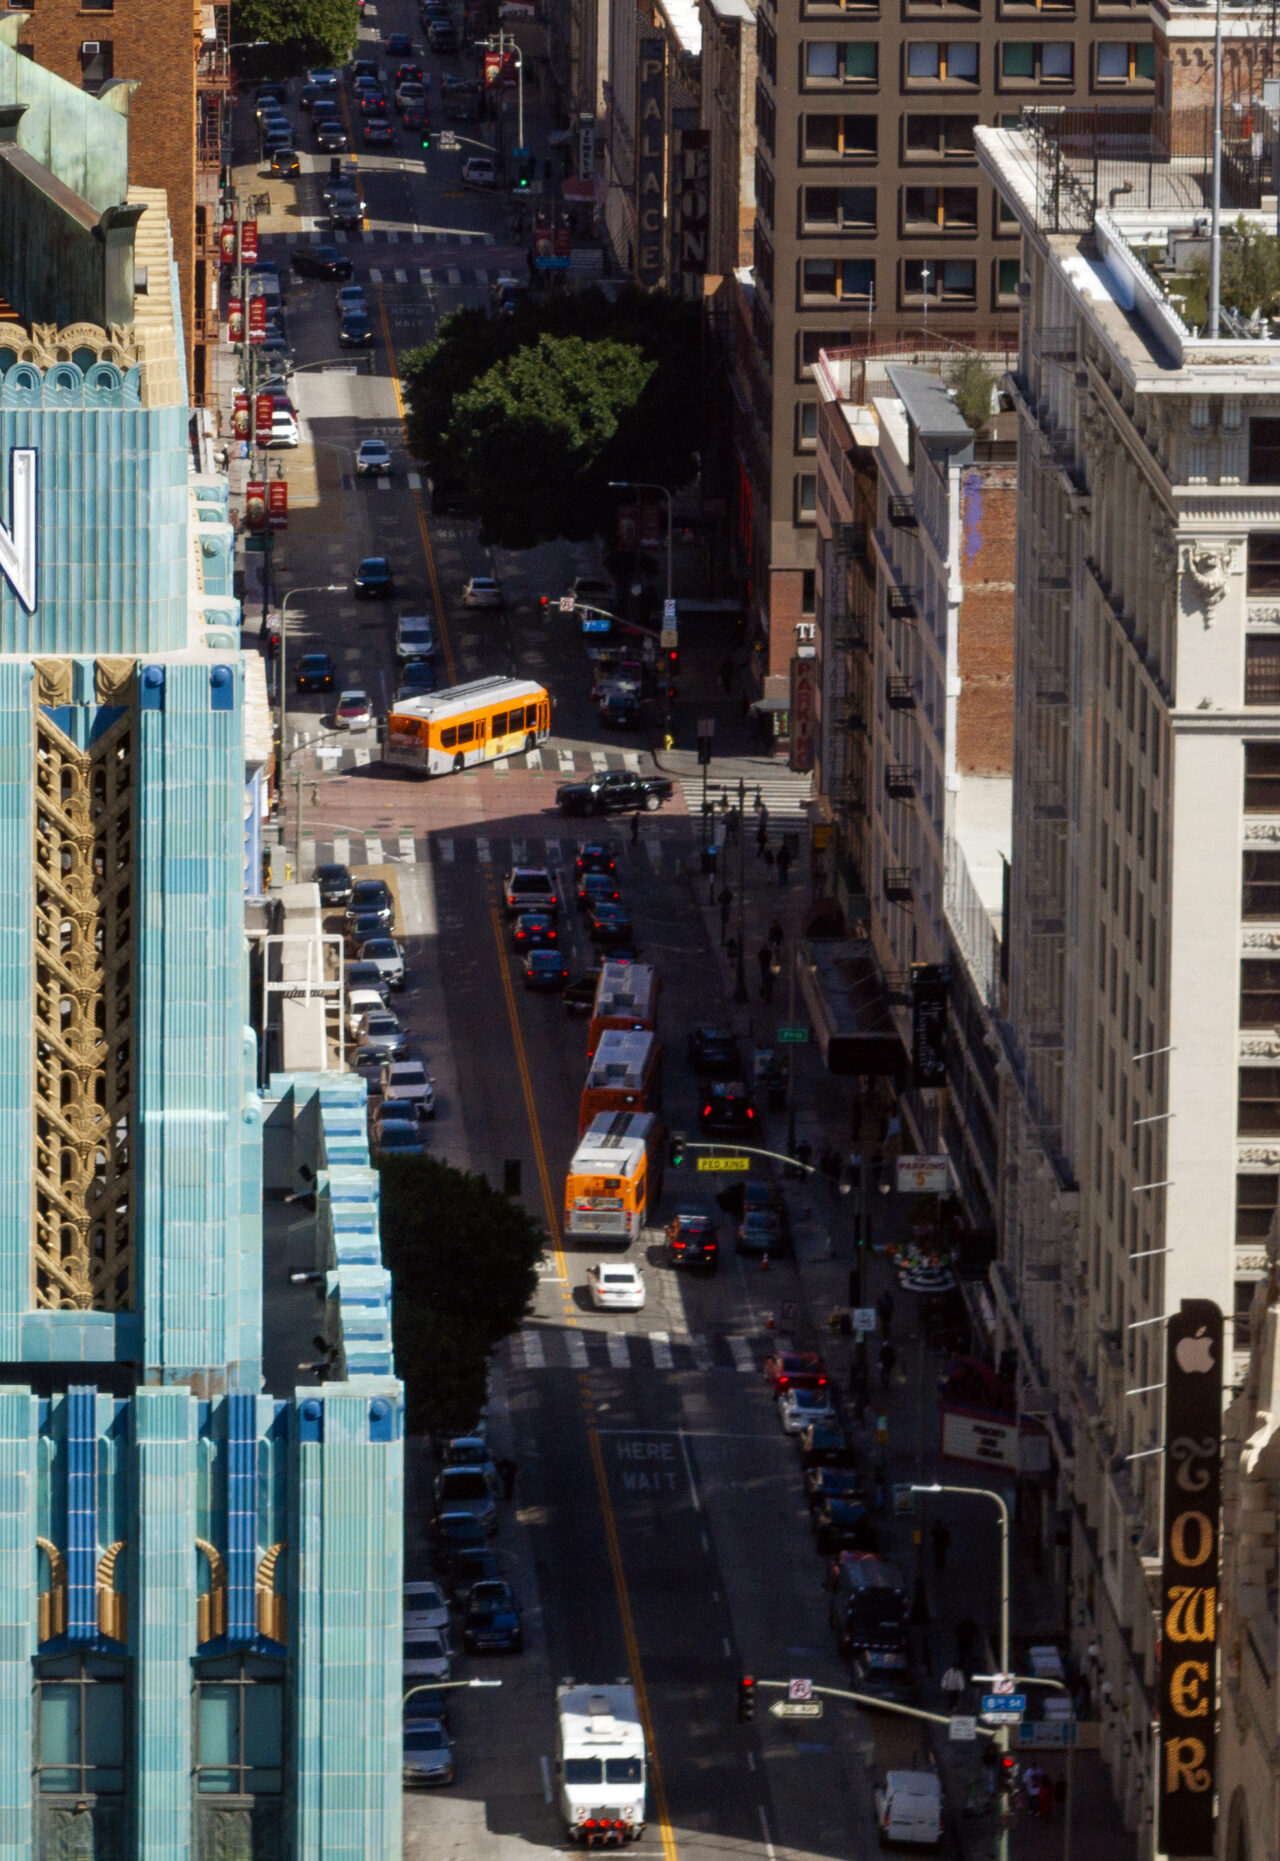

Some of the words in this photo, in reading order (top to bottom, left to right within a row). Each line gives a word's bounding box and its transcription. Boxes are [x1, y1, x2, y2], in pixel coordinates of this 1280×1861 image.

[642, 60, 662, 268] PALACE
[796, 662, 811, 768] PARKING
[702, 1160, 721, 1169] PED
[724, 1160, 746, 1169] XING
[899, 1162, 945, 1170] PARKING
[616, 1442, 675, 1460] HERE
[622, 1472, 677, 1490] WAIT
[1164, 1436, 1218, 1793] TOWER
